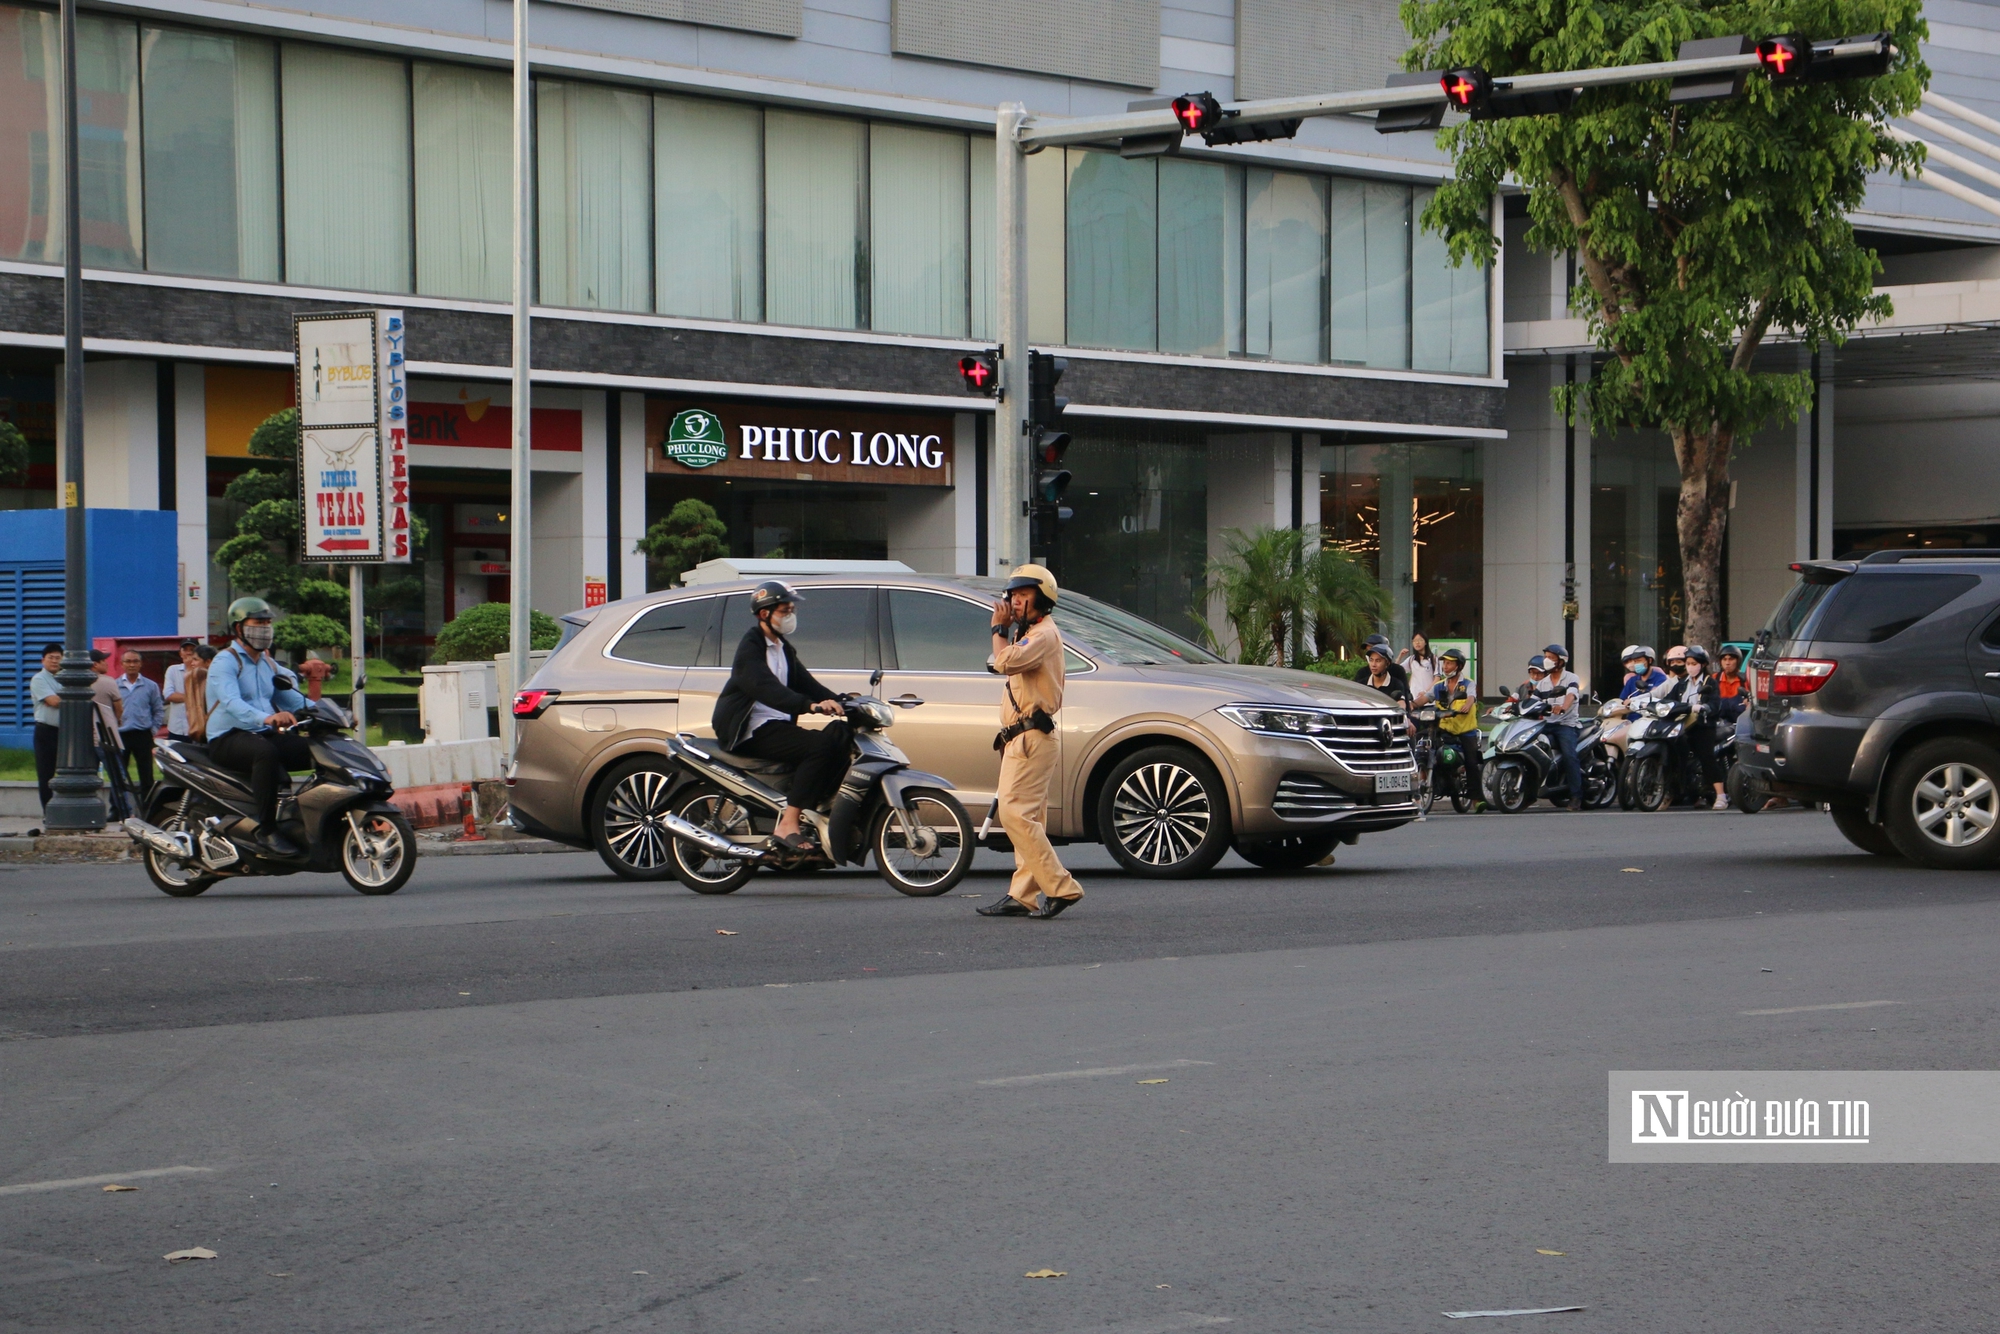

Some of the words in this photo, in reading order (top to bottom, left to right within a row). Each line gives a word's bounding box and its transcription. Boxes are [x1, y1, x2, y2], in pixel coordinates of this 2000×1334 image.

[327, 365, 372, 382] BYBLOS
[385, 316, 405, 421] BYBLOS
[408, 410, 459, 441] ank
[667, 443, 697, 455] PHUC
[698, 444, 727, 457] LONG
[739, 424, 841, 464] PHUC
[850, 431, 944, 469] LONG
[388, 427, 409, 557] TEXAS
[316, 492, 365, 526] TEXAS
[708, 764, 747, 783] SIRIUS
[850, 770, 872, 782] YAMAHA
